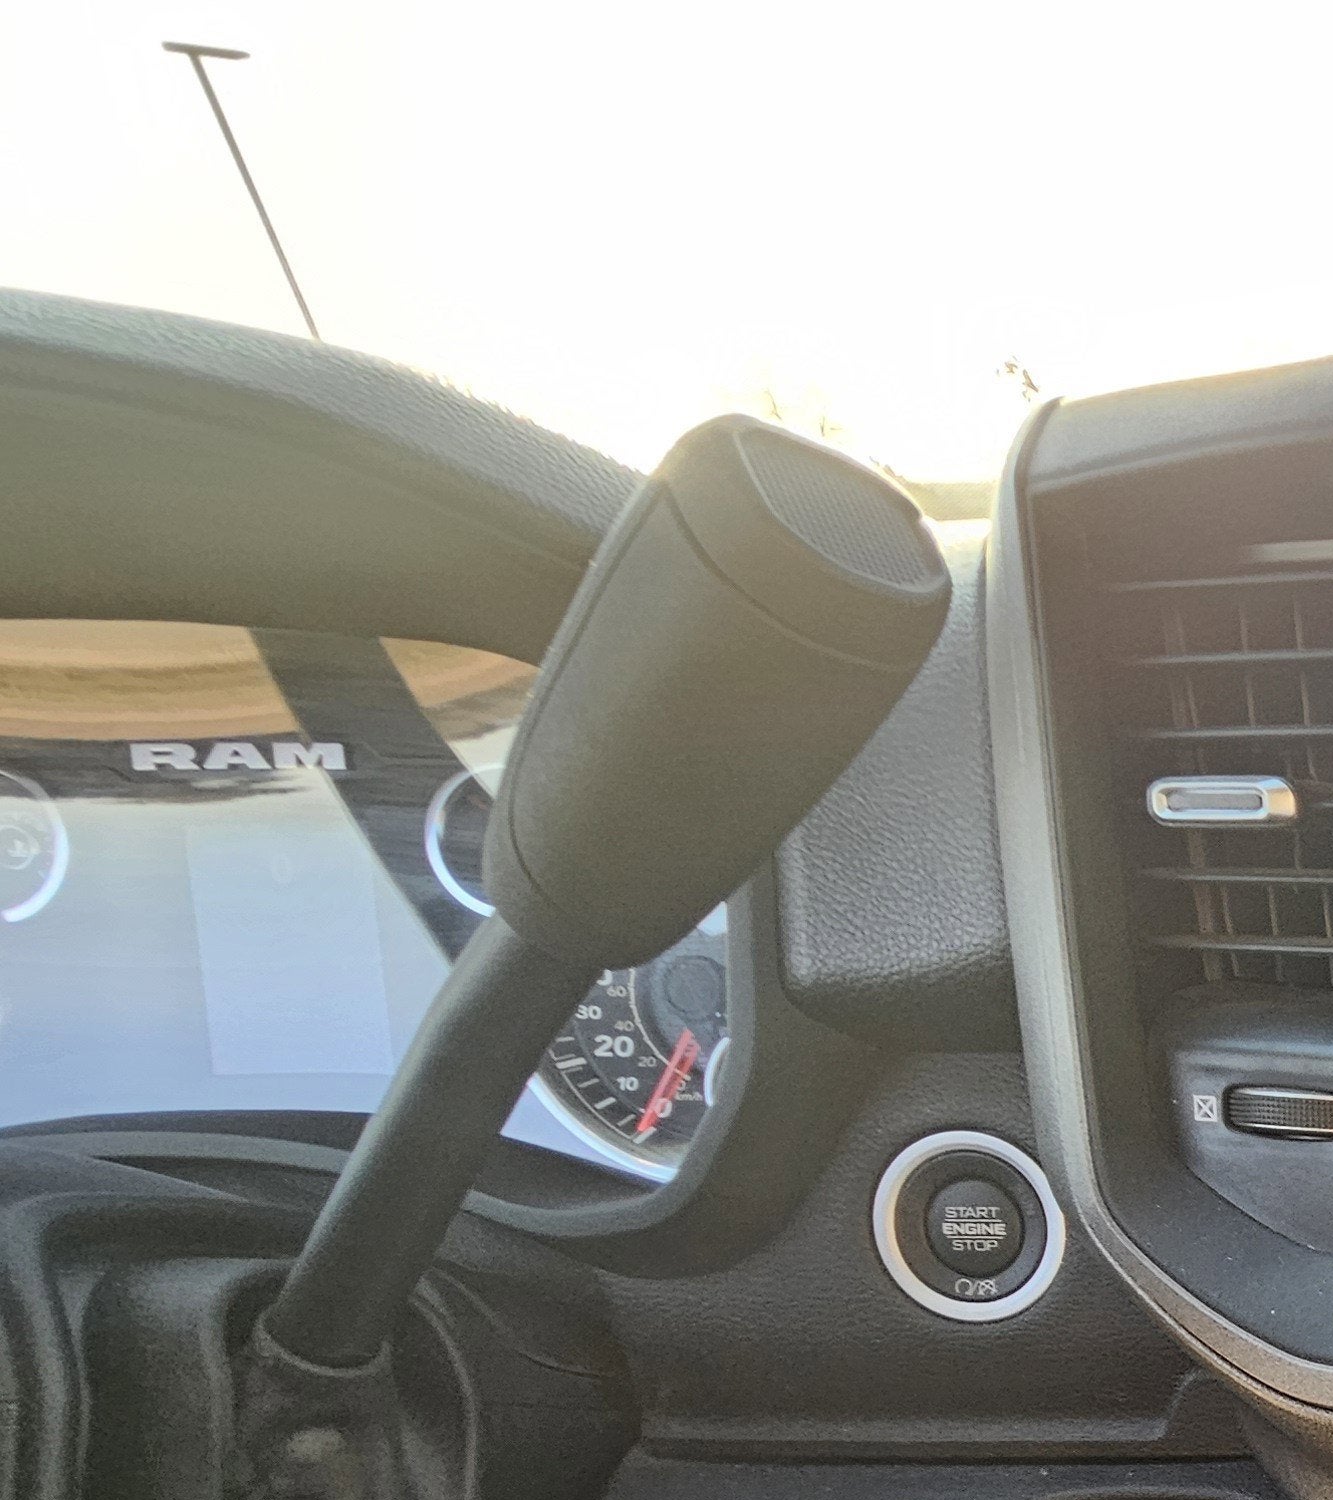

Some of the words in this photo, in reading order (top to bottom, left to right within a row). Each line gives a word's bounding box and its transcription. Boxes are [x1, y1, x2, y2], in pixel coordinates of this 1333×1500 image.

[129, 742, 347, 772] RAM
[606, 985, 628, 998] 60
[574, 1004, 603, 1020] 30
[613, 1019, 635, 1032] 40
[593, 1034, 635, 1058] 20
[637, 1055, 658, 1068] 20
[616, 1076, 640, 1092] 10
[944, 1206, 1001, 1218] START
[941, 1222, 1007, 1236] ENGINE
[952, 1239, 999, 1252] STOP
